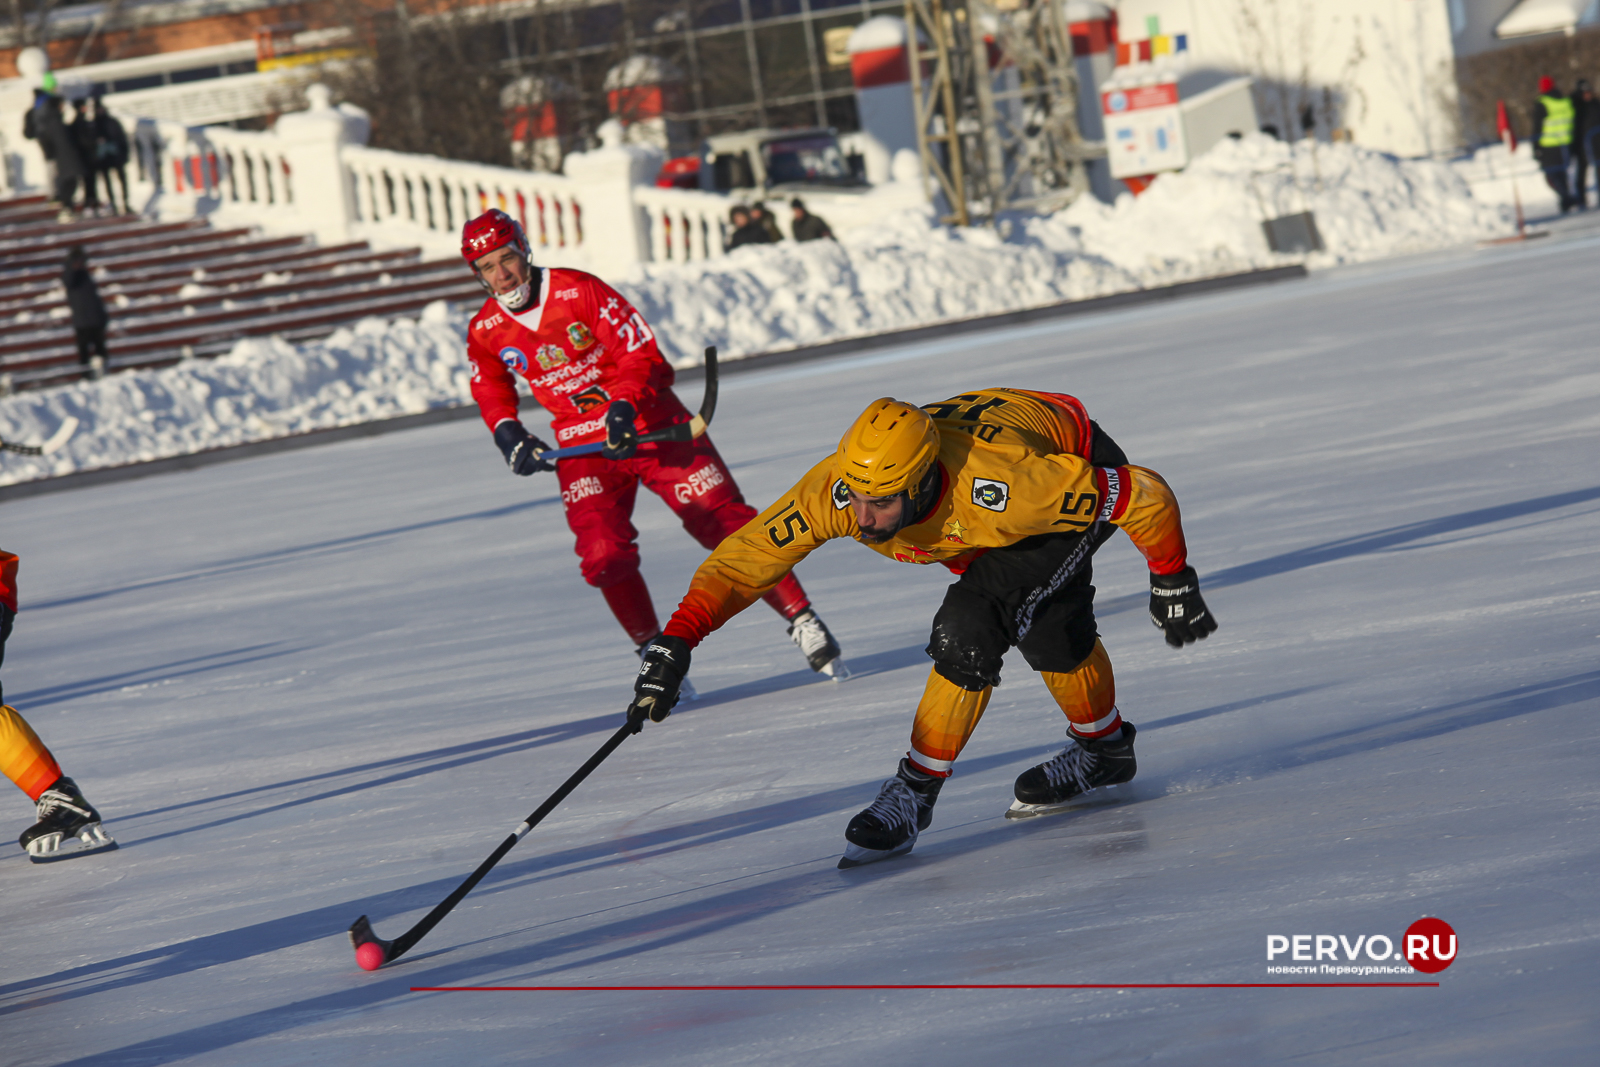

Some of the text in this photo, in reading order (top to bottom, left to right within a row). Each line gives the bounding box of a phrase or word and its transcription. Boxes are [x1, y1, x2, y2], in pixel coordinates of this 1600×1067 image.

[483, 312, 504, 330] ВТБ
[569, 476, 600, 494] SIMA
[688, 463, 719, 487] SIMA
[693, 472, 724, 496] LAND
[571, 484, 604, 503] LAND
[1101, 472, 1119, 517] CAPTAIN
[1051, 491, 1097, 527] 15
[763, 499, 811, 549] 15
[1167, 604, 1184, 618] 15
